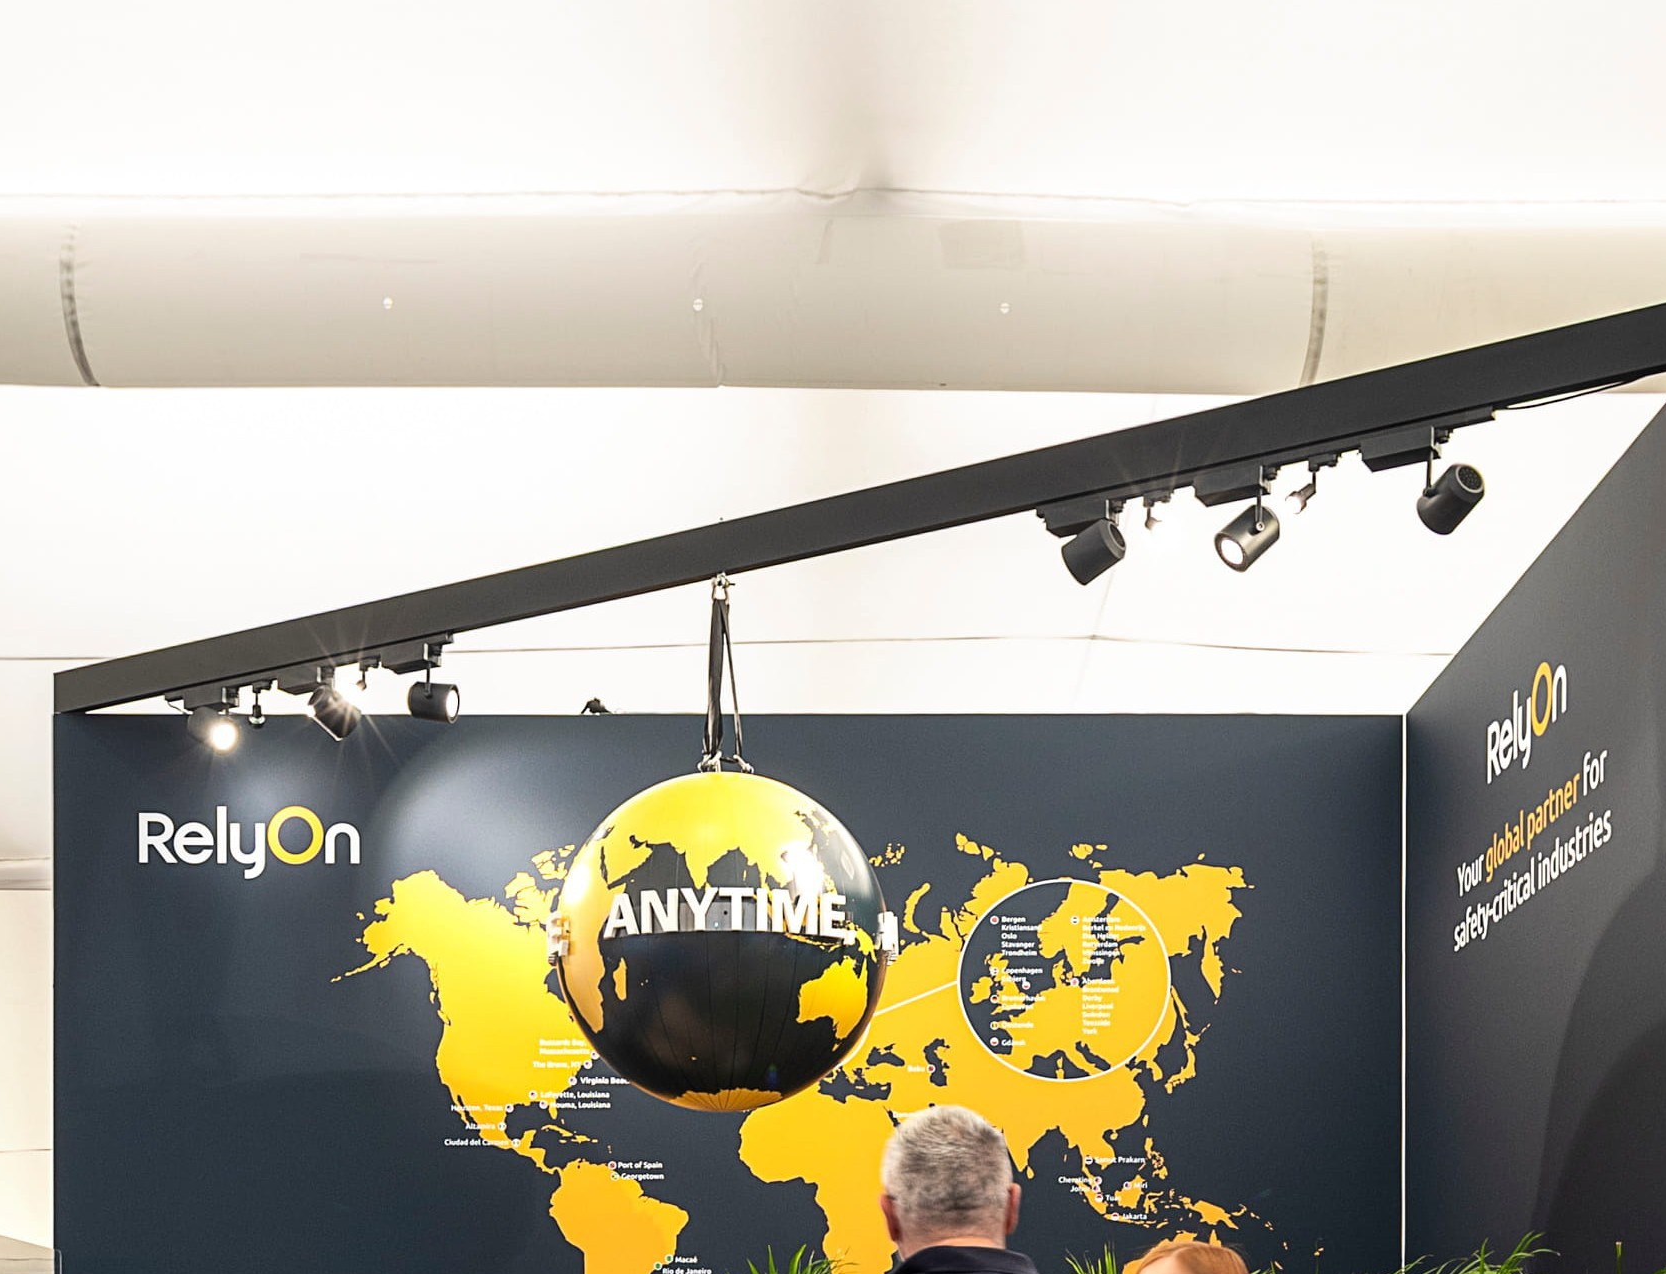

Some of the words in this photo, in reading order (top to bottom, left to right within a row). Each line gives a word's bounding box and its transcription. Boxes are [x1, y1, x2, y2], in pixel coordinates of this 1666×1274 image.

[1487, 661, 1568, 785] RelyOn
[1456, 854, 1485, 897] Your
[1485, 809, 1524, 883] global
[1526, 772, 1581, 851] partner
[1583, 749, 1608, 796] for
[137, 805, 361, 880] RelyOn
[1453, 856, 1536, 952] safety-critical
[1537, 809, 1612, 890] industries
[603, 887, 847, 940] ANYTIME
[1001, 941, 1034, 949] Stavanger
[580, 1076, 609, 1085] Virginia
[578, 1101, 611, 1109] Louisiana
[444, 1138, 468, 1146] Ciudad
[470, 1138, 481, 1146] del
[618, 1161, 631, 1169] Port
[643, 1161, 663, 1170] Spain
[621, 1173, 664, 1181] Georgetown
